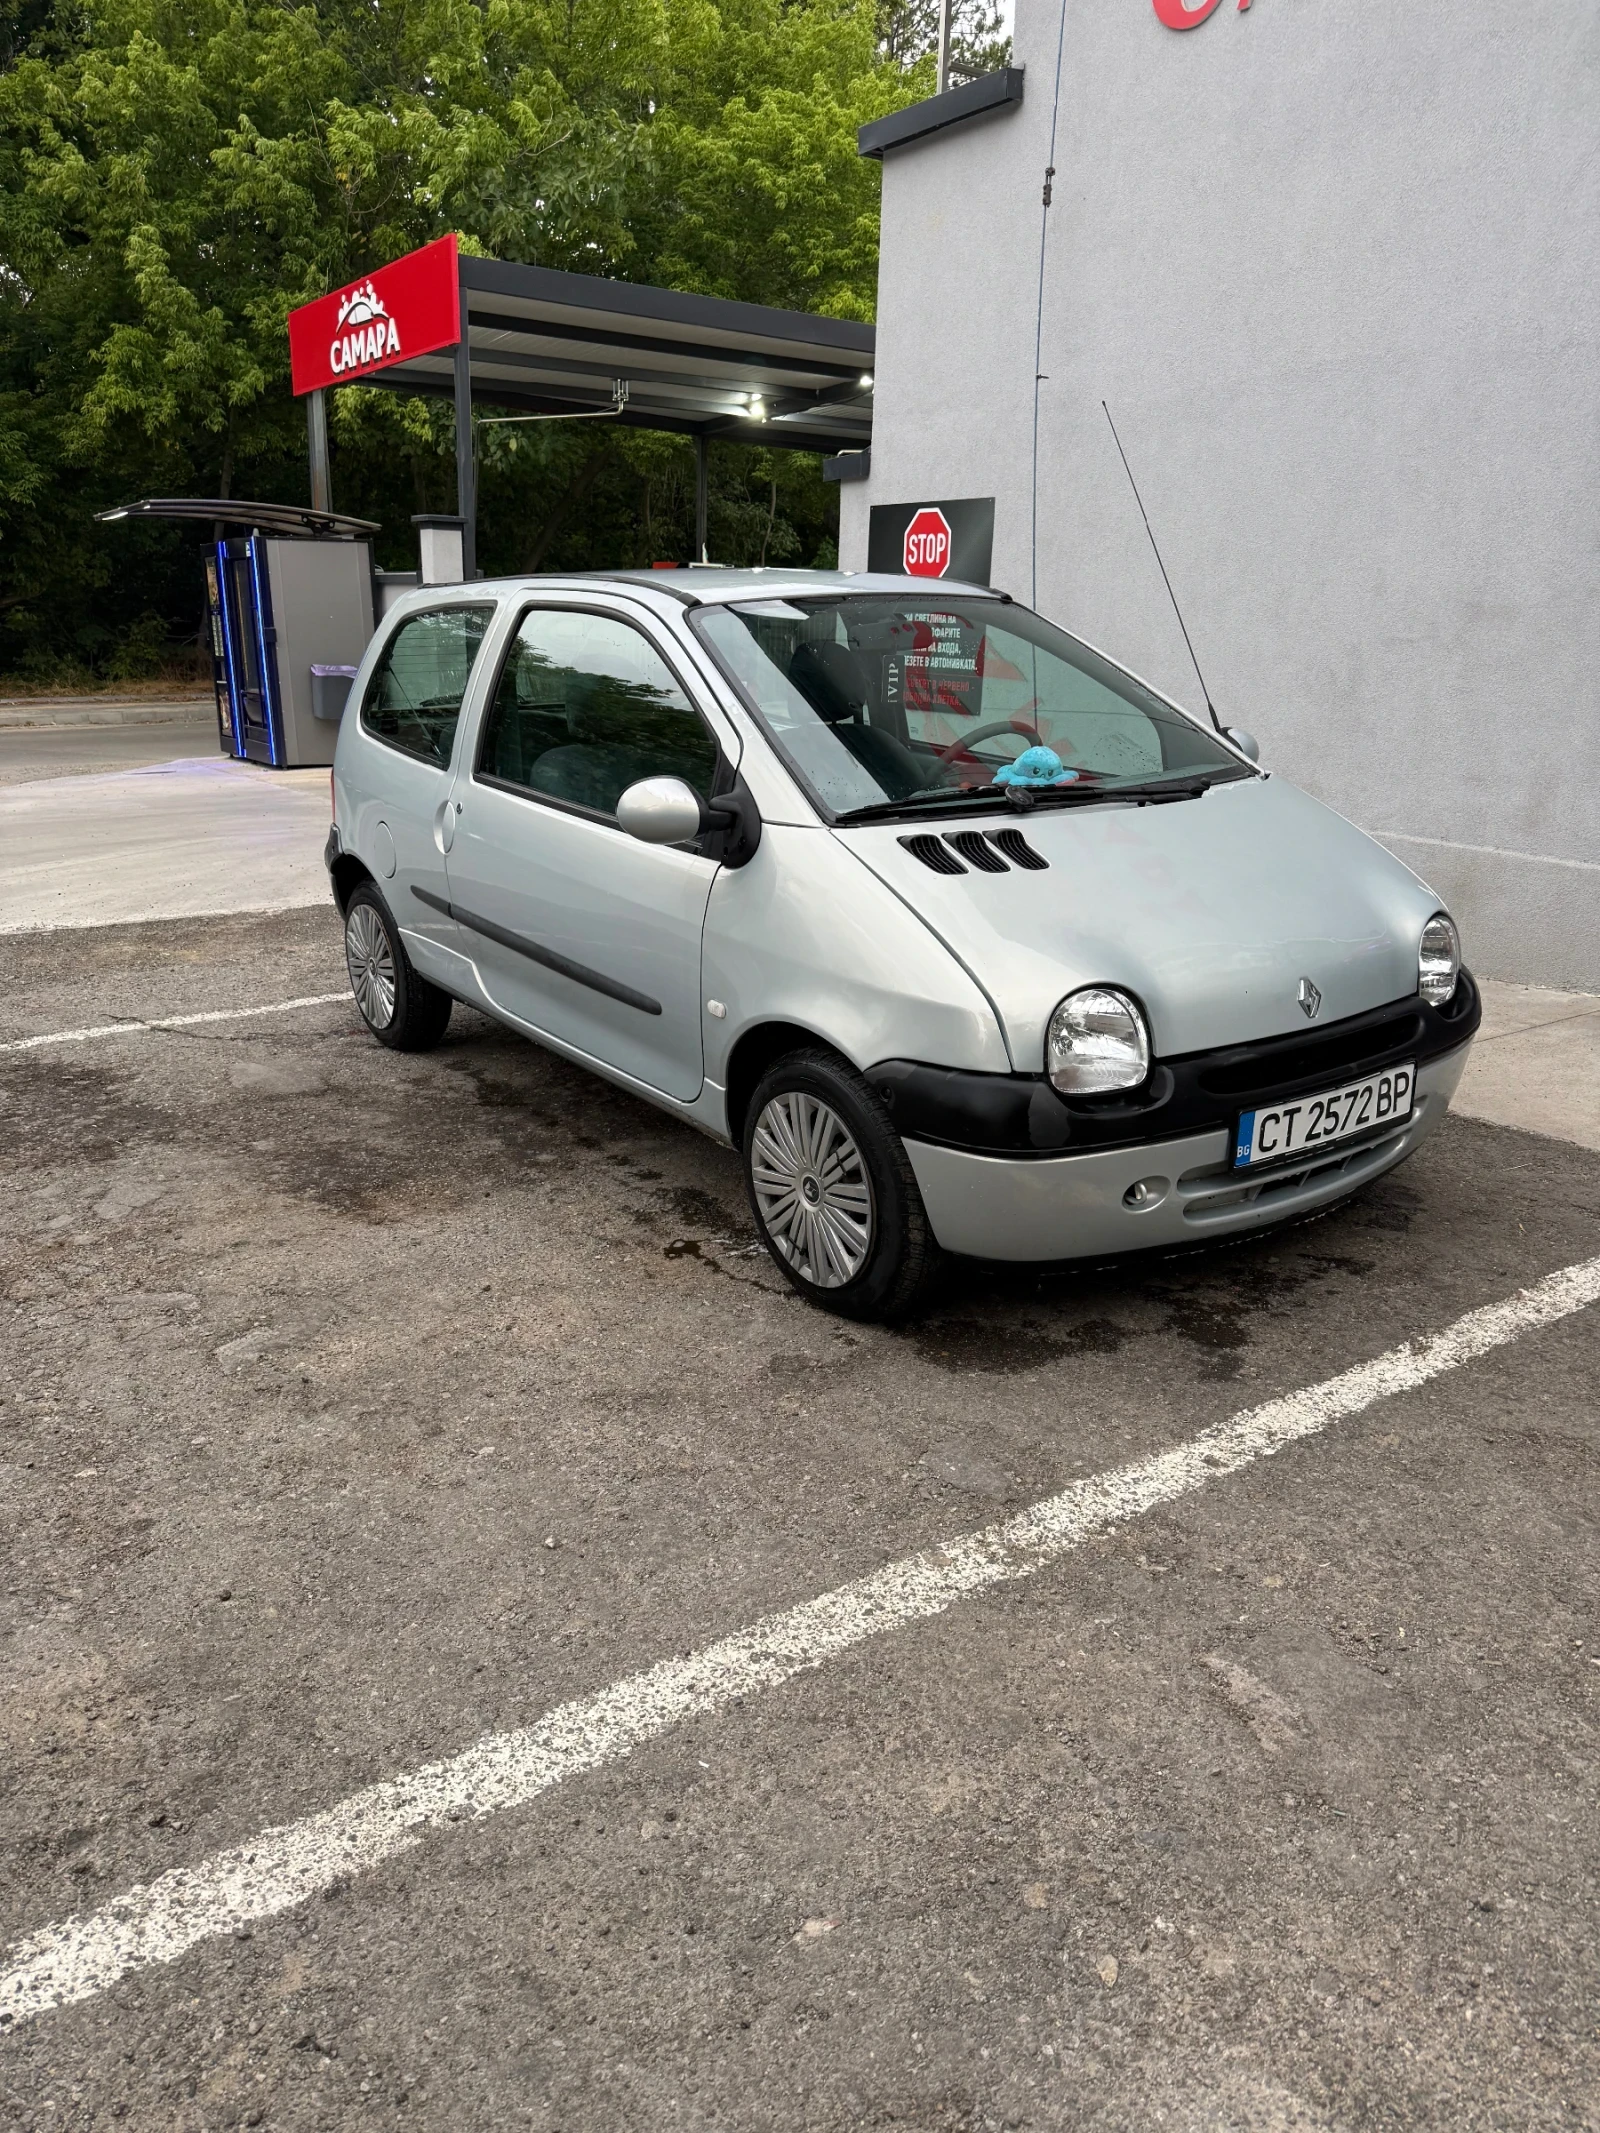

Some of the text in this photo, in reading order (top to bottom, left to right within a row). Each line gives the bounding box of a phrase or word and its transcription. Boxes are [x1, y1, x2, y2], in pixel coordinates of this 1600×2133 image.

[330, 318, 400, 374] САМАРА
[908, 532, 946, 564] STOP
[914, 613, 947, 623] СВЕТЛИНА
[947, 615, 957, 624] НА
[937, 642, 961, 656] ВХОДА,
[925, 656, 930, 667] В
[930, 657, 978, 671] АВТОМИВКАТА.
[888, 662, 899, 697] VIP
[939, 680, 970, 692] ЧЕРВЕНО
[1258, 1071, 1410, 1152] CT 2572 BP
[1237, 1144, 1250, 1158] BG
